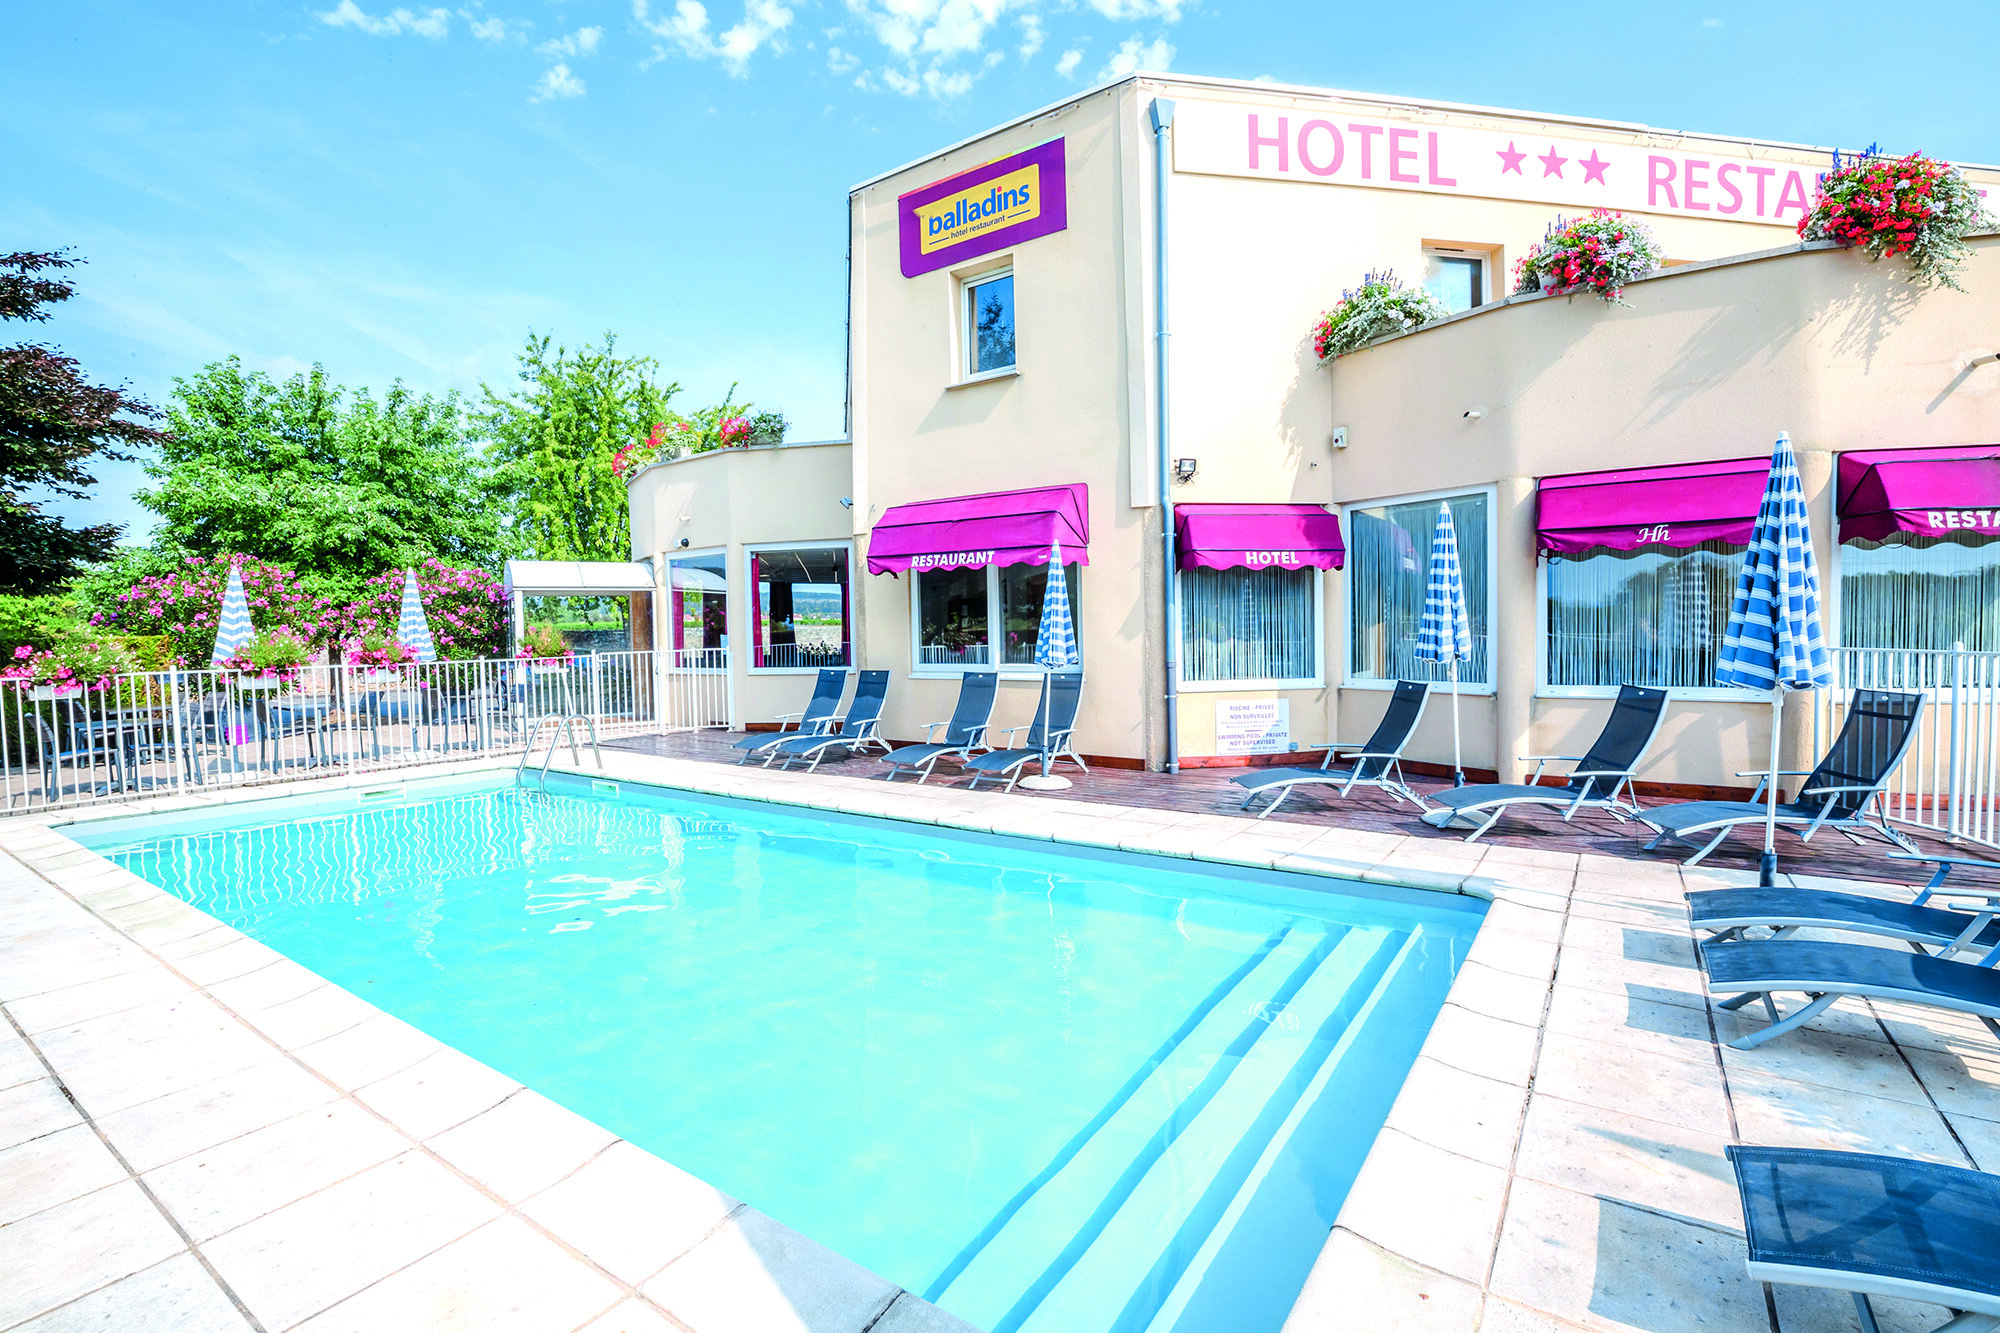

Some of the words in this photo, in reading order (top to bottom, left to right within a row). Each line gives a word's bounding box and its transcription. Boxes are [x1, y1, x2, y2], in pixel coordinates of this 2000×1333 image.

[1247, 113, 1457, 187] HOTEL
[928, 184, 1030, 236] palladins
[950, 222, 969, 239] hôtel
[969, 214, 1006, 232] restaurant
[911, 551, 995, 567] RESTAURANT
[1245, 551, 1300, 564] HOTEL
